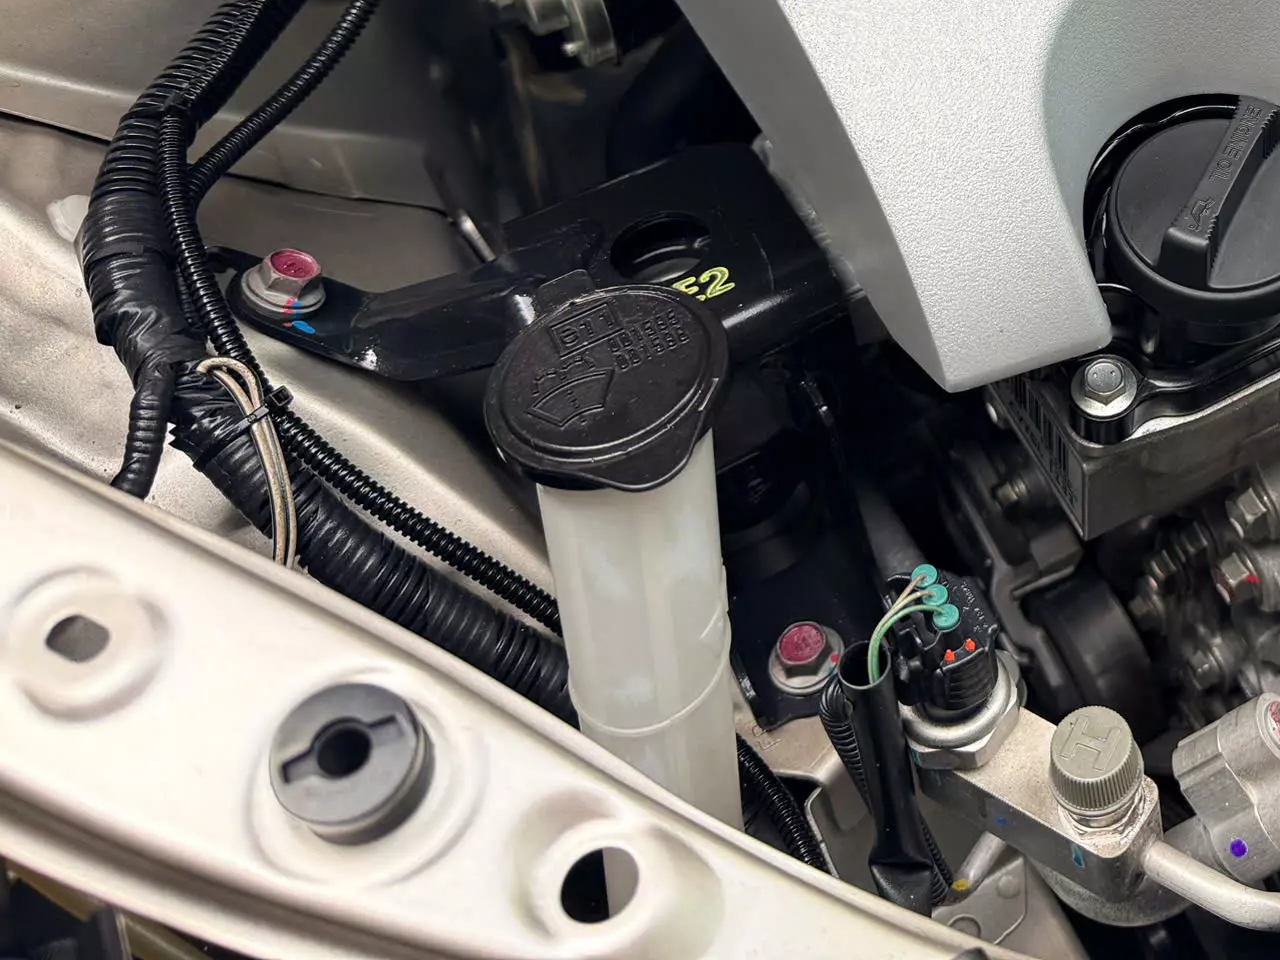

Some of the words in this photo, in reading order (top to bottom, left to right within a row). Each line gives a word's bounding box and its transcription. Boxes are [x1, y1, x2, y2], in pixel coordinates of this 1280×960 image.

[1224, 105, 1262, 160] ENGINE
[1209, 157, 1233, 182] OIL
[1060, 714, 1122, 772] H
